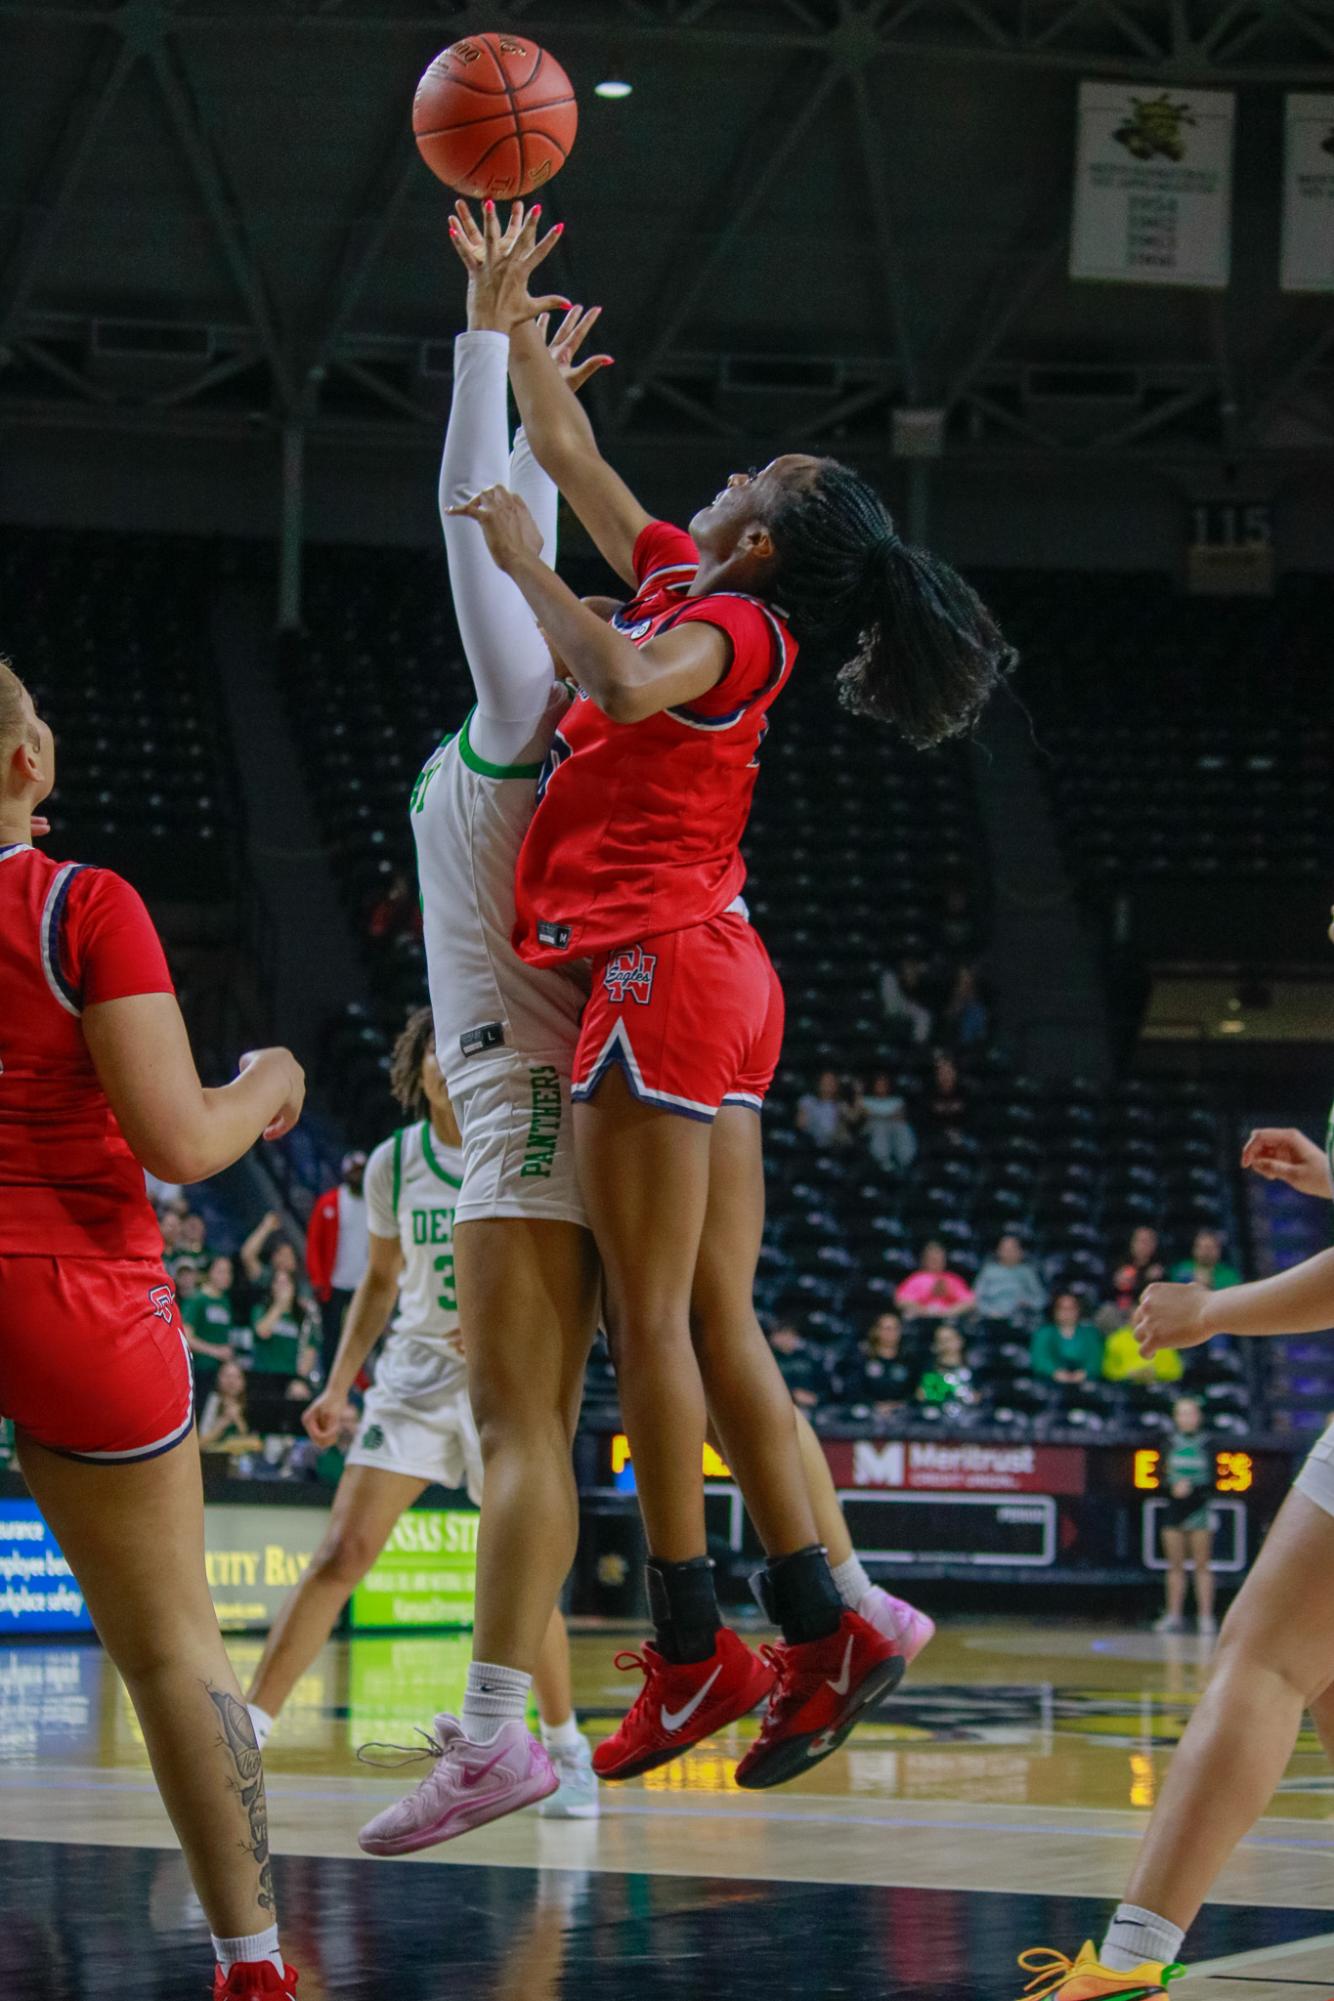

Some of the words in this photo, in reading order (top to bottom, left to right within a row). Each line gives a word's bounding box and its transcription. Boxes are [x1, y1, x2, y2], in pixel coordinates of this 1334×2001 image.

[605, 966, 651, 988] Eagles
[487, 1031, 497, 1041] L
[520, 1065, 562, 1179] PANTHERS
